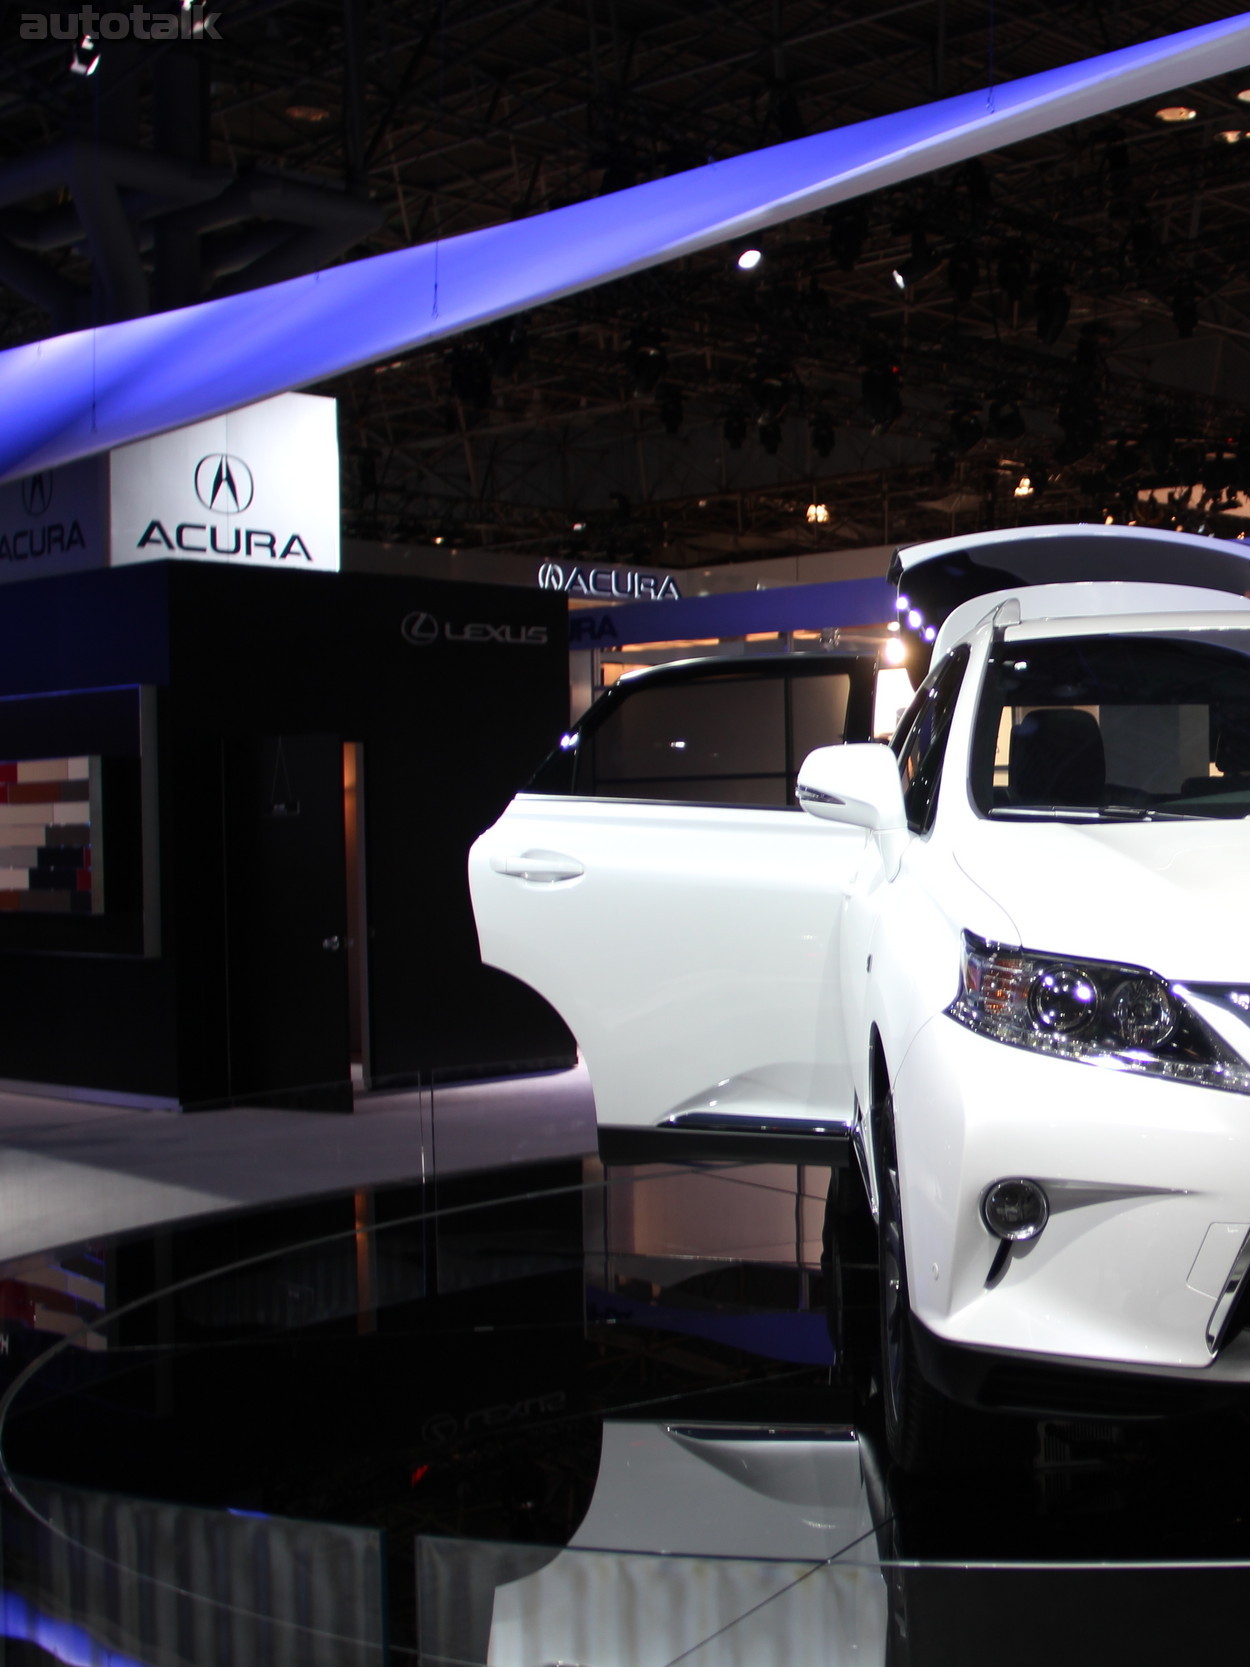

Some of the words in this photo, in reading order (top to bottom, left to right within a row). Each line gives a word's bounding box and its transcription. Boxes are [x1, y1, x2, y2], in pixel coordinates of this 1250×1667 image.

[136, 520, 313, 561] ACURA
[563, 566, 681, 601] ACURA
[443, 621, 549, 645] LEXUS
